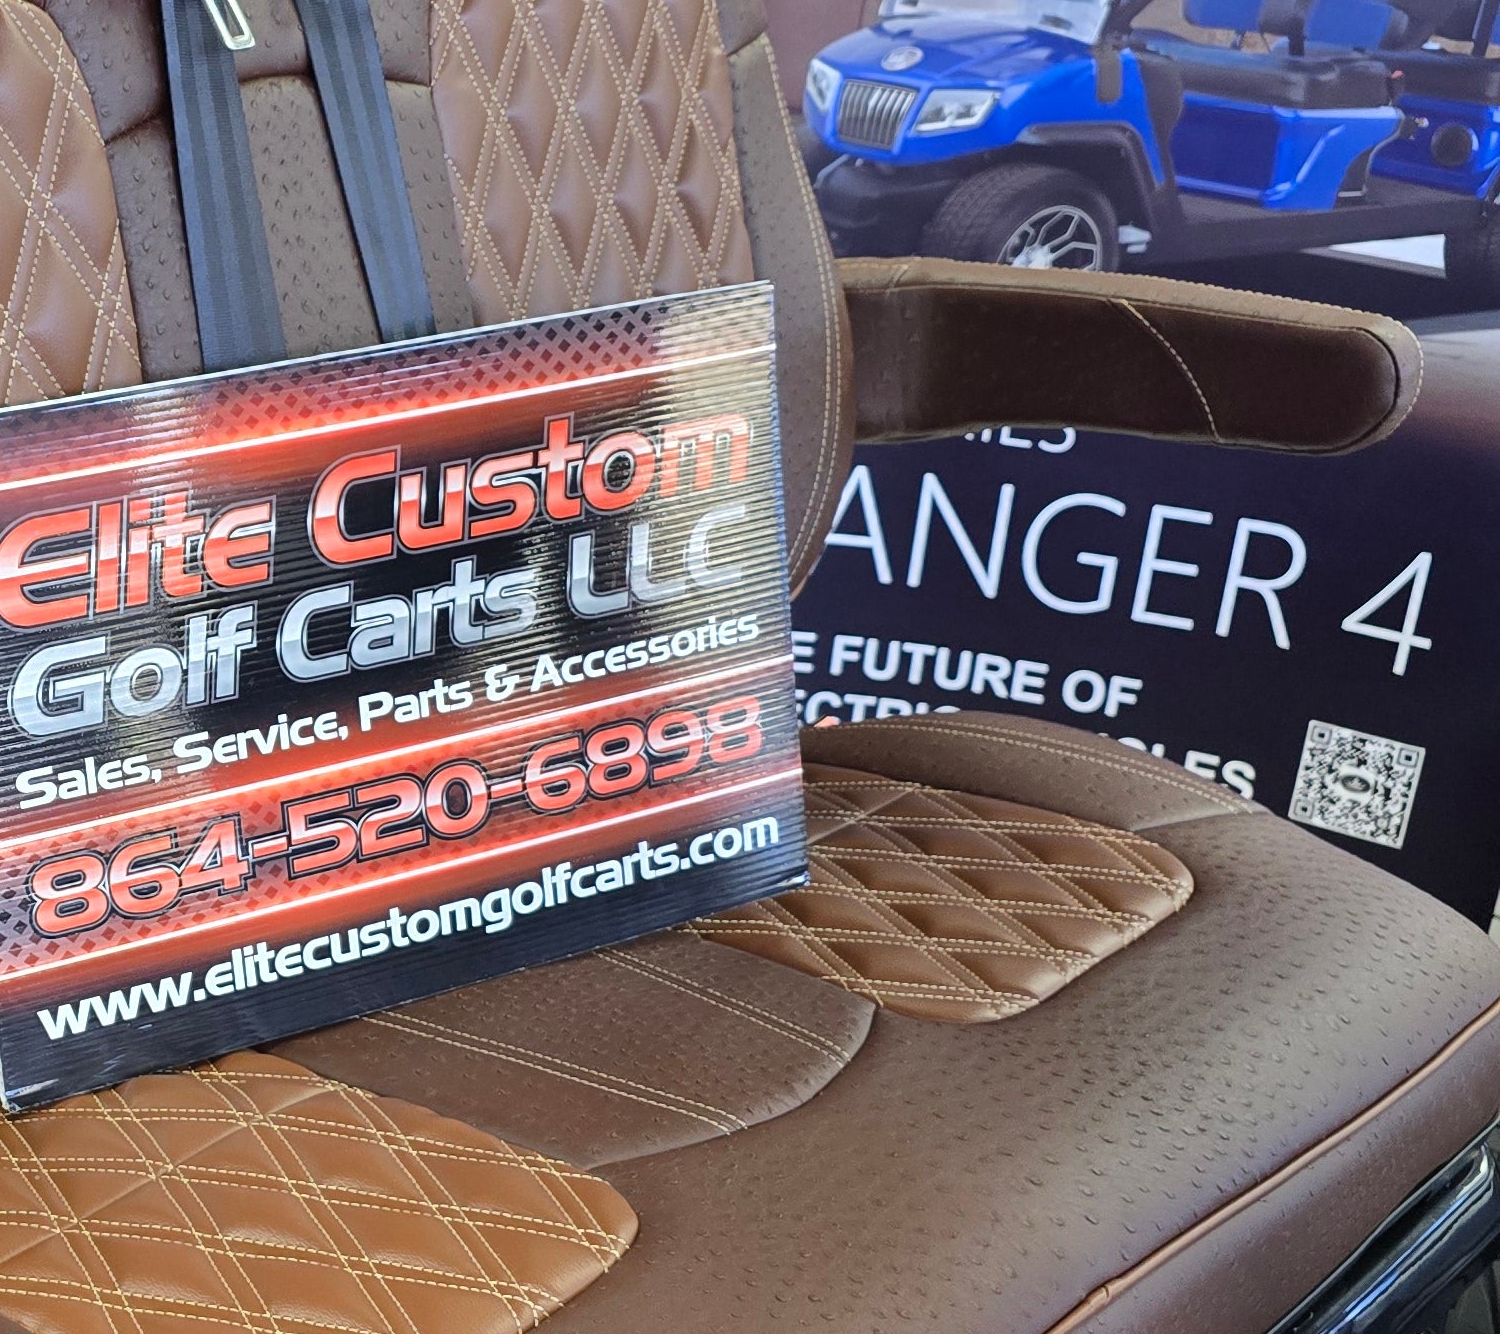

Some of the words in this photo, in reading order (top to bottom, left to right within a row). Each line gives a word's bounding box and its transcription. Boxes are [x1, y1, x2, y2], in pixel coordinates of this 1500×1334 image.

[308, 412, 755, 564] Custom
[824, 466, 1308, 650] ANGER
[1341, 552, 1433, 677] 4
[10, 605, 257, 738] Golf
[277, 557, 541, 684] Carts
[564, 505, 747, 620] LLC
[16, 753, 164, 810] Sales,
[173, 705, 351, 772] Service,
[359, 679, 474, 735] Parts
[485, 666, 518, 704] &
[530, 612, 761, 694] Accessories
[829, 634, 1049, 704] FUTURE
[1062, 670, 1143, 717] OF
[30, 694, 767, 944] 864-520-6898
[38, 815, 782, 1042] www.elitecustomgolfcarts.com
